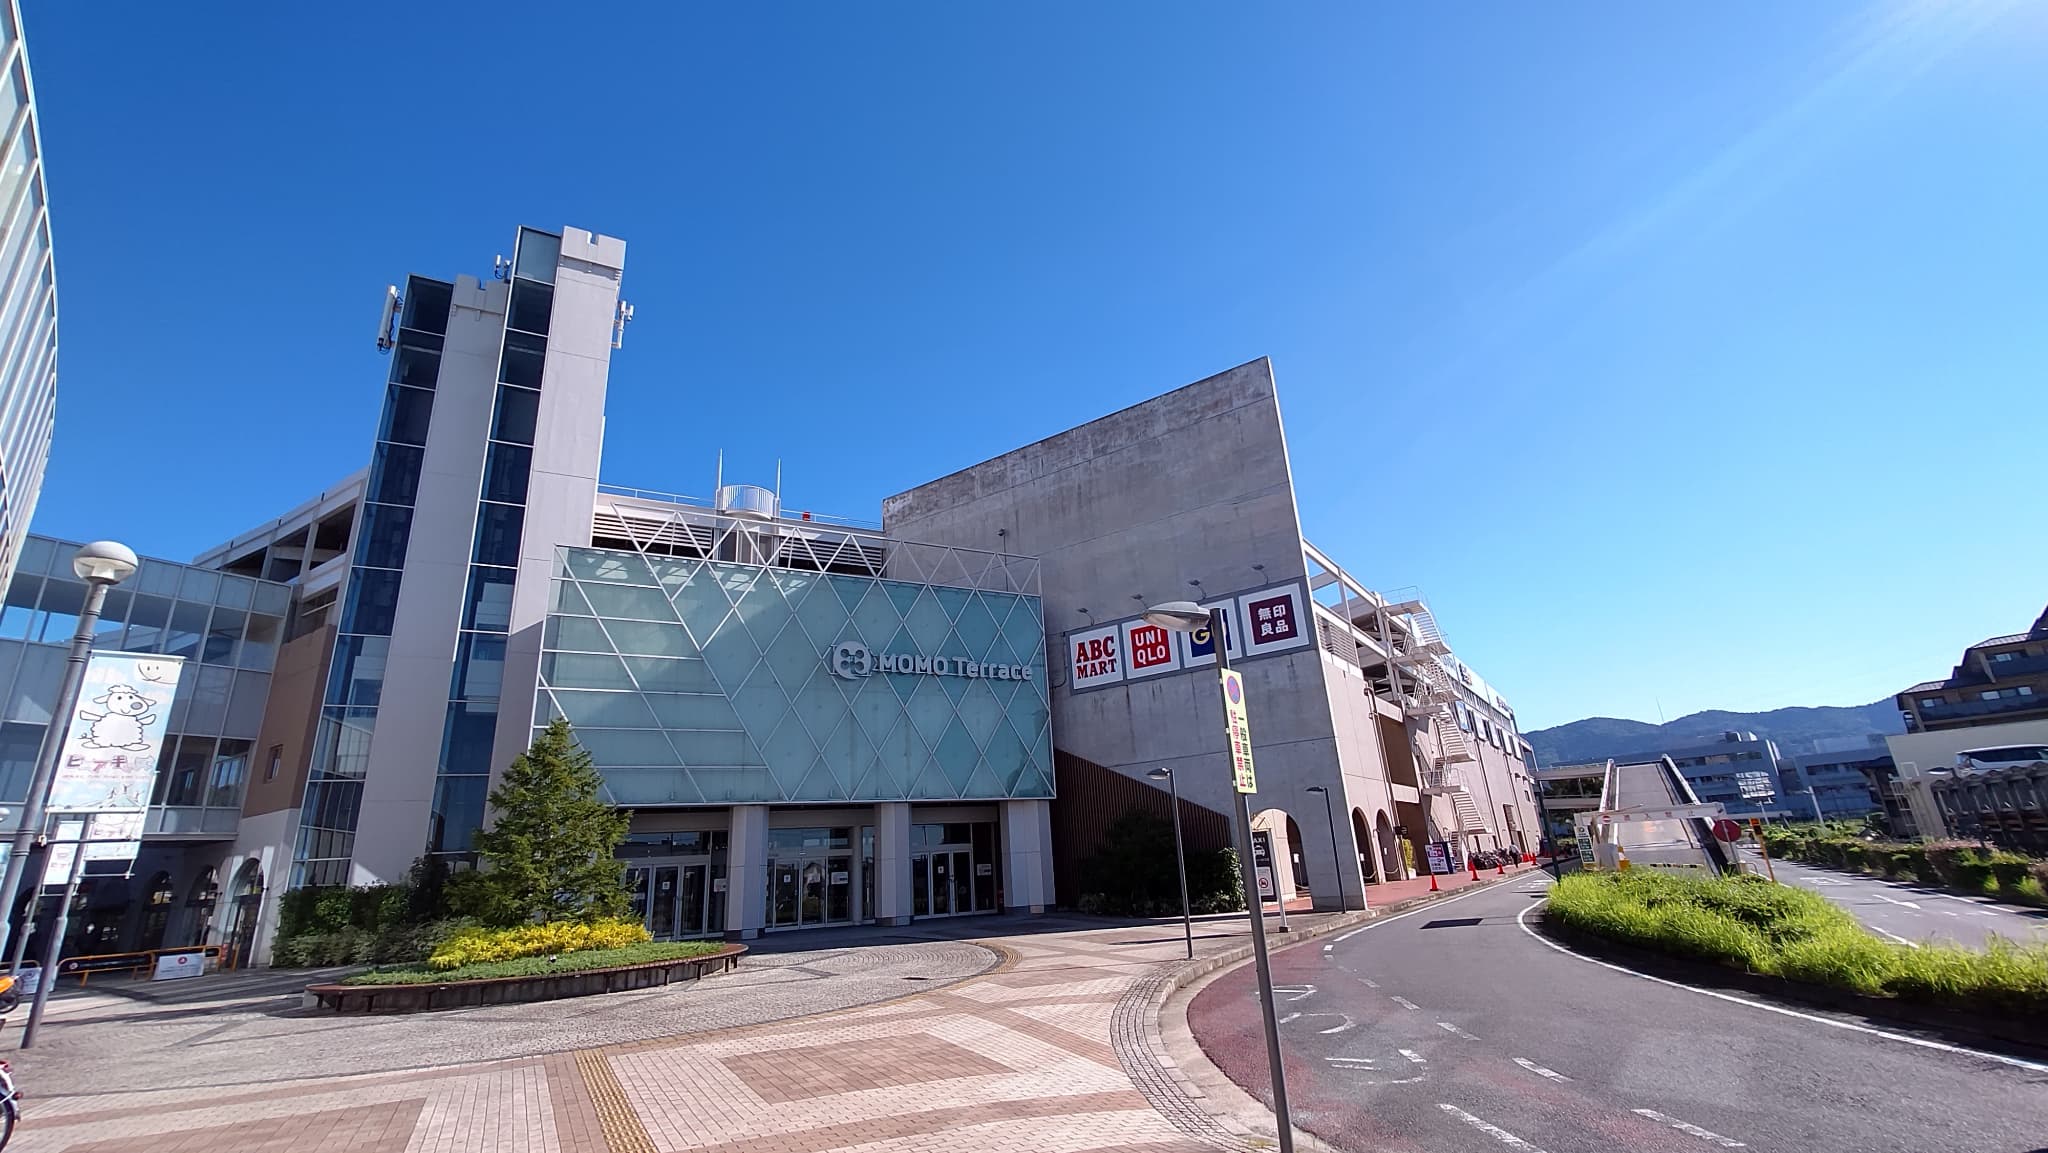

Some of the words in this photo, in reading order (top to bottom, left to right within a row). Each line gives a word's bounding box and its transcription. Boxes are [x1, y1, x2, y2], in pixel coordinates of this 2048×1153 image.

[1257, 604, 1286, 621] 無印
[1135, 629, 1162, 647] UNI
[1260, 621, 1290, 637] 良品
[1076, 635, 1116, 664] ABC
[1136, 645, 1166, 665] QLO
[879, 654, 948, 679] MOMO
[955, 656, 1033, 681] Terrace
[1077, 658, 1117, 680] MART
